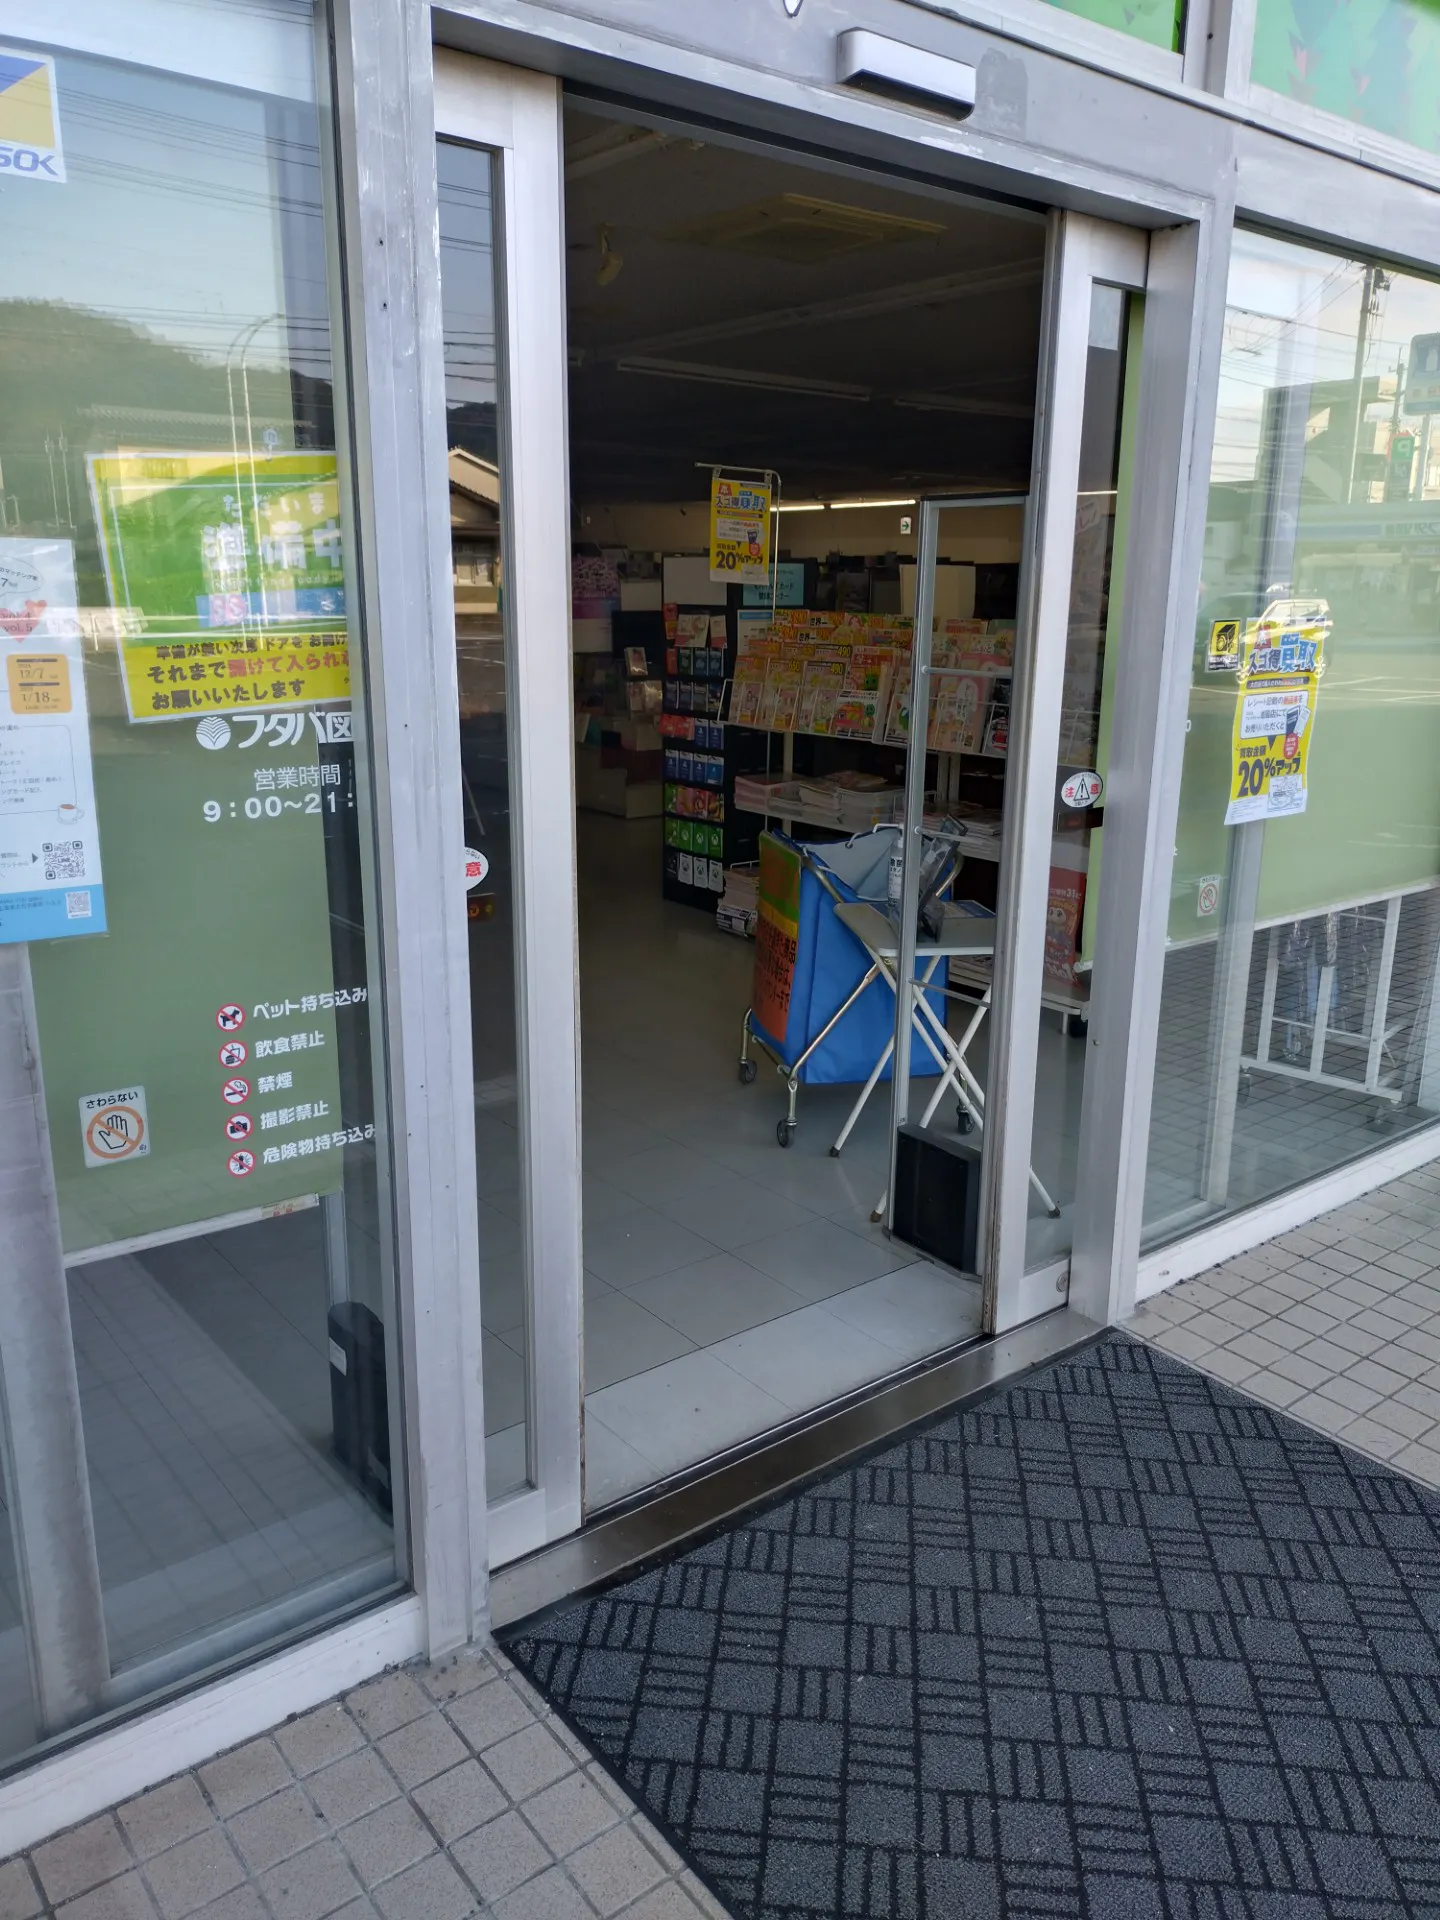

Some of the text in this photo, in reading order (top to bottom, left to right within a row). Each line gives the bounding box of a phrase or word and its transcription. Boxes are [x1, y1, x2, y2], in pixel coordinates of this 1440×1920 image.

[152, 679, 305, 711] お願いいたします
[232, 711, 353, 749] フタバ図
[1240, 745, 1267, 757] 買取金額
[254, 764, 341, 791] 営業時間
[253, 987, 368, 1020] ペット持ち込み
[255, 1030, 326, 1058] 飲食禁止
[257, 1071, 293, 1094] 禁煙
[86, 1090, 139, 1109] さわらない
[260, 1100, 330, 1130] 撮影禁止
[263, 1124, 376, 1165] 危険物持ち込み
